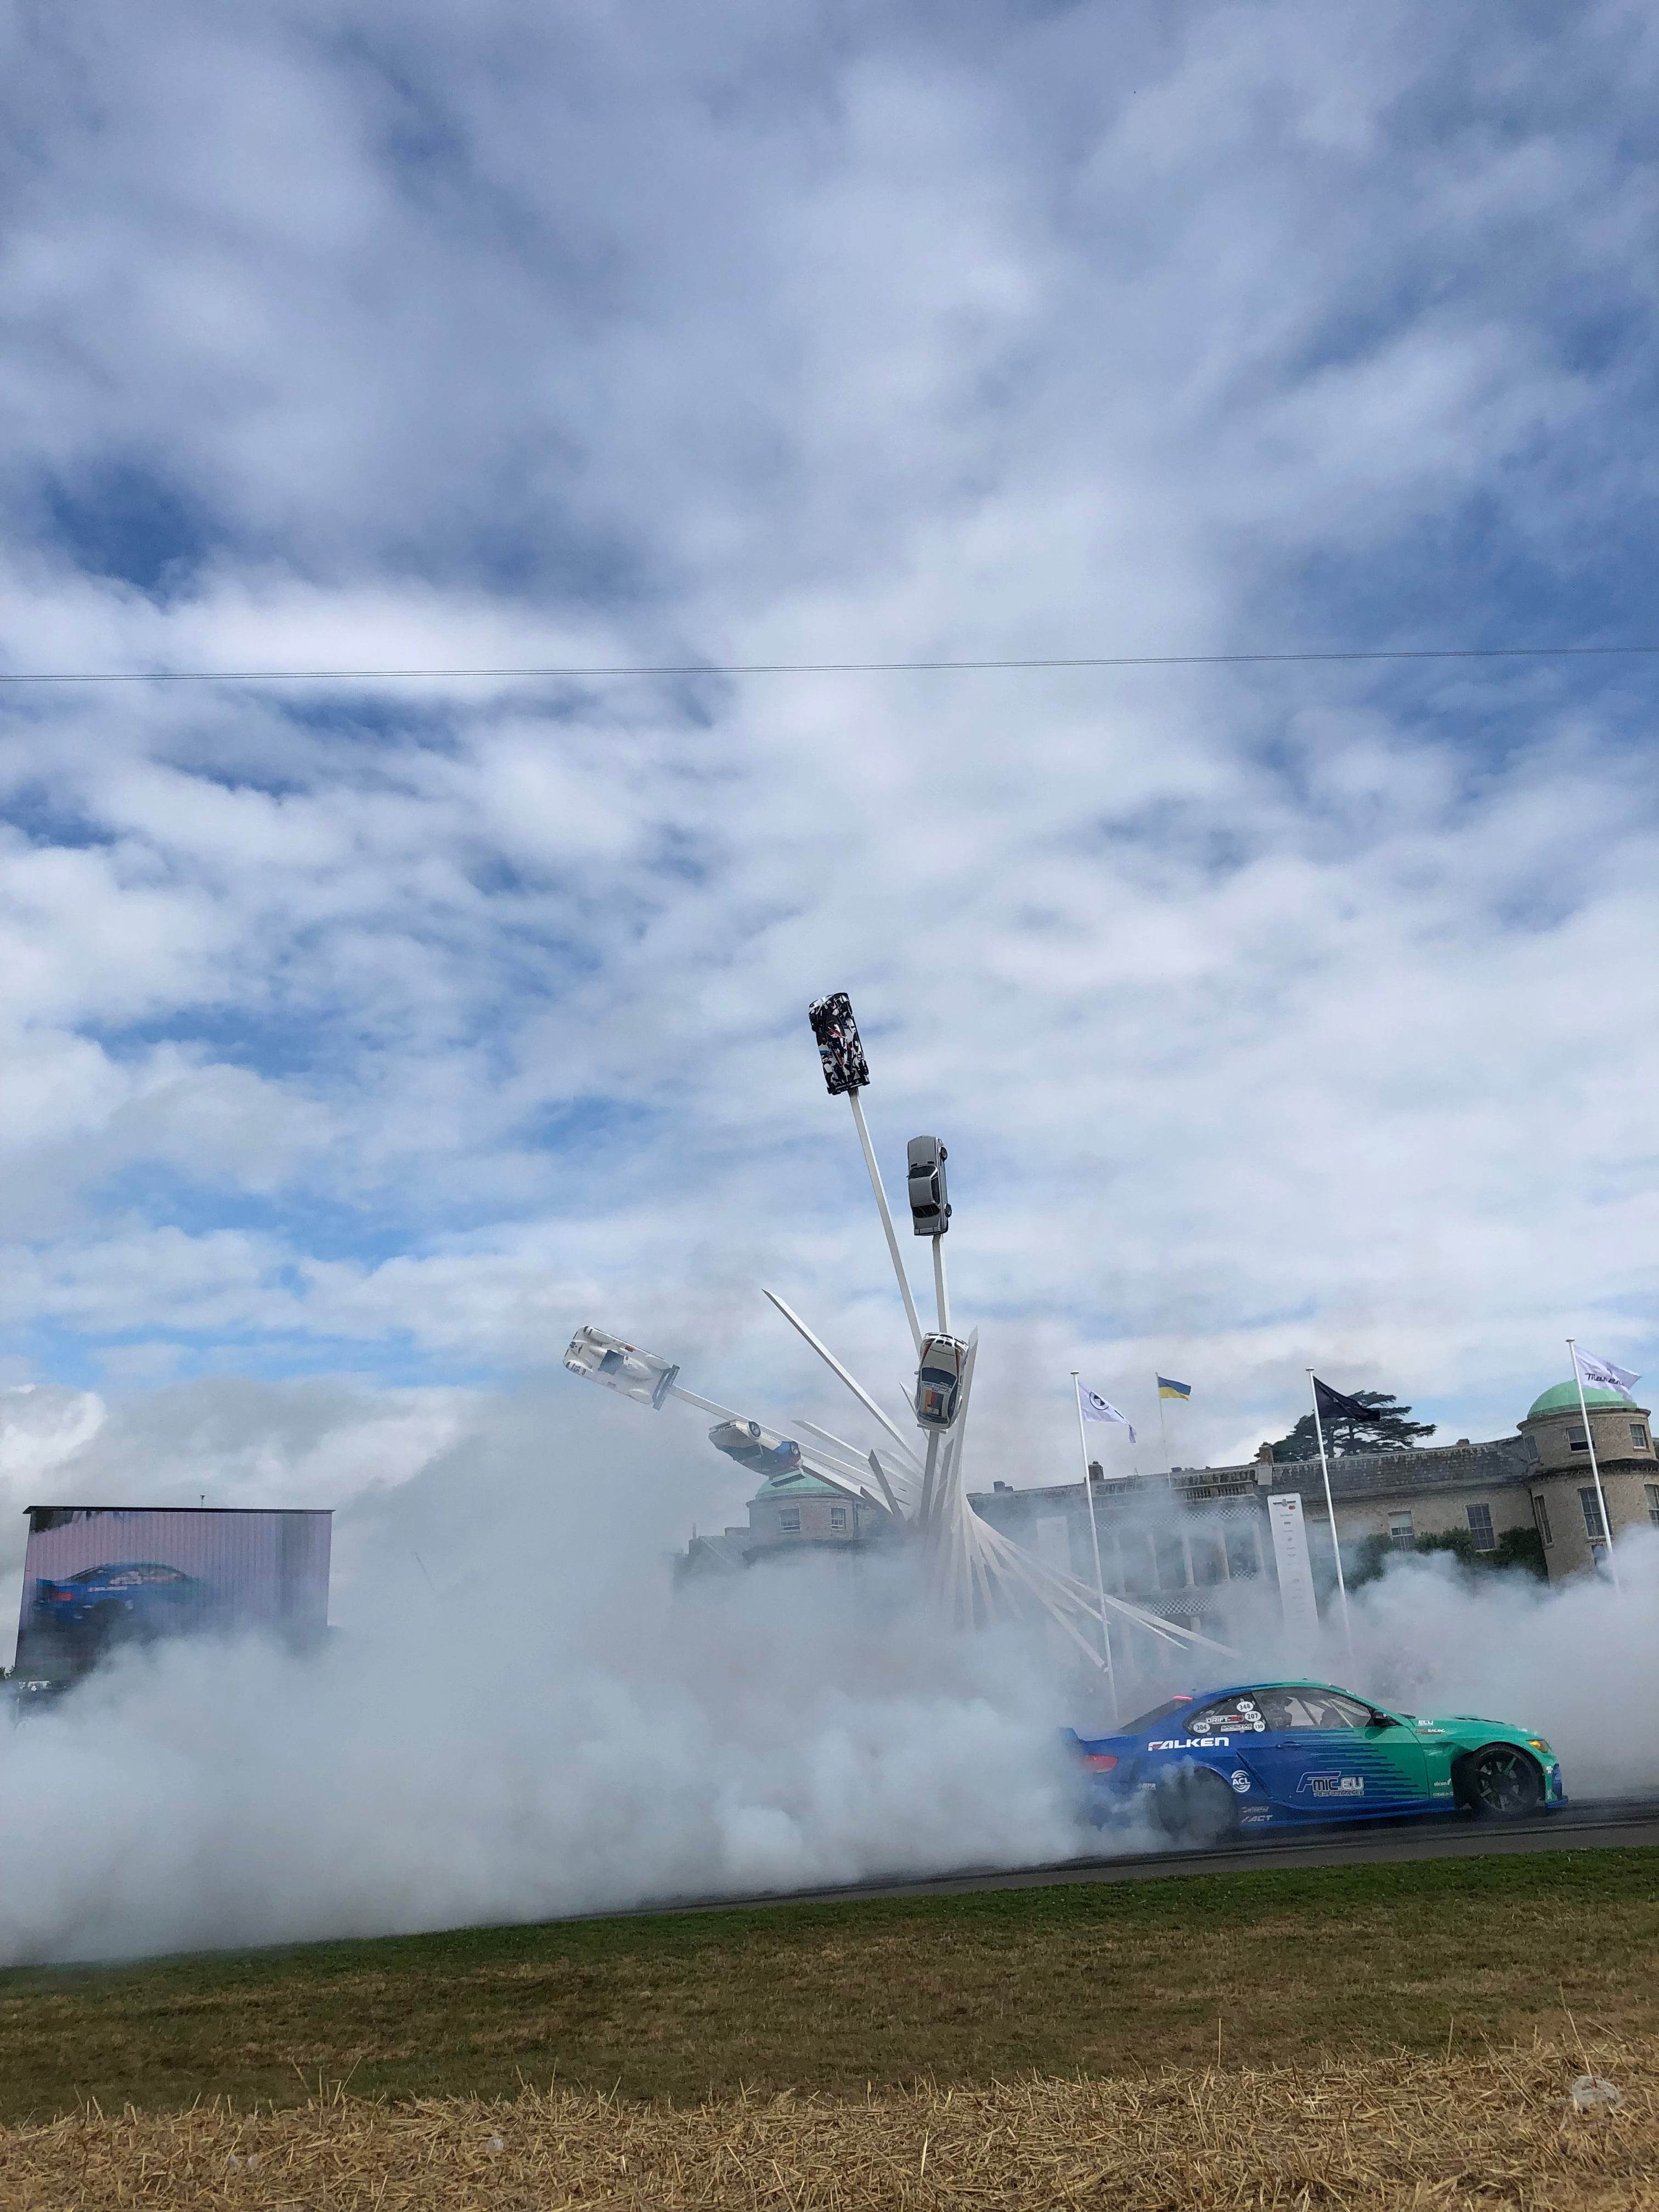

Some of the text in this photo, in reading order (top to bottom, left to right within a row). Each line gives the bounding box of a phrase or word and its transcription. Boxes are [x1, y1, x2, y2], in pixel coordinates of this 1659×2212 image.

[1148, 1737, 1229, 1751] FALKEN
[1232, 1777, 1251, 1786] ACL
[1247, 1814, 1273, 1823] ACT
